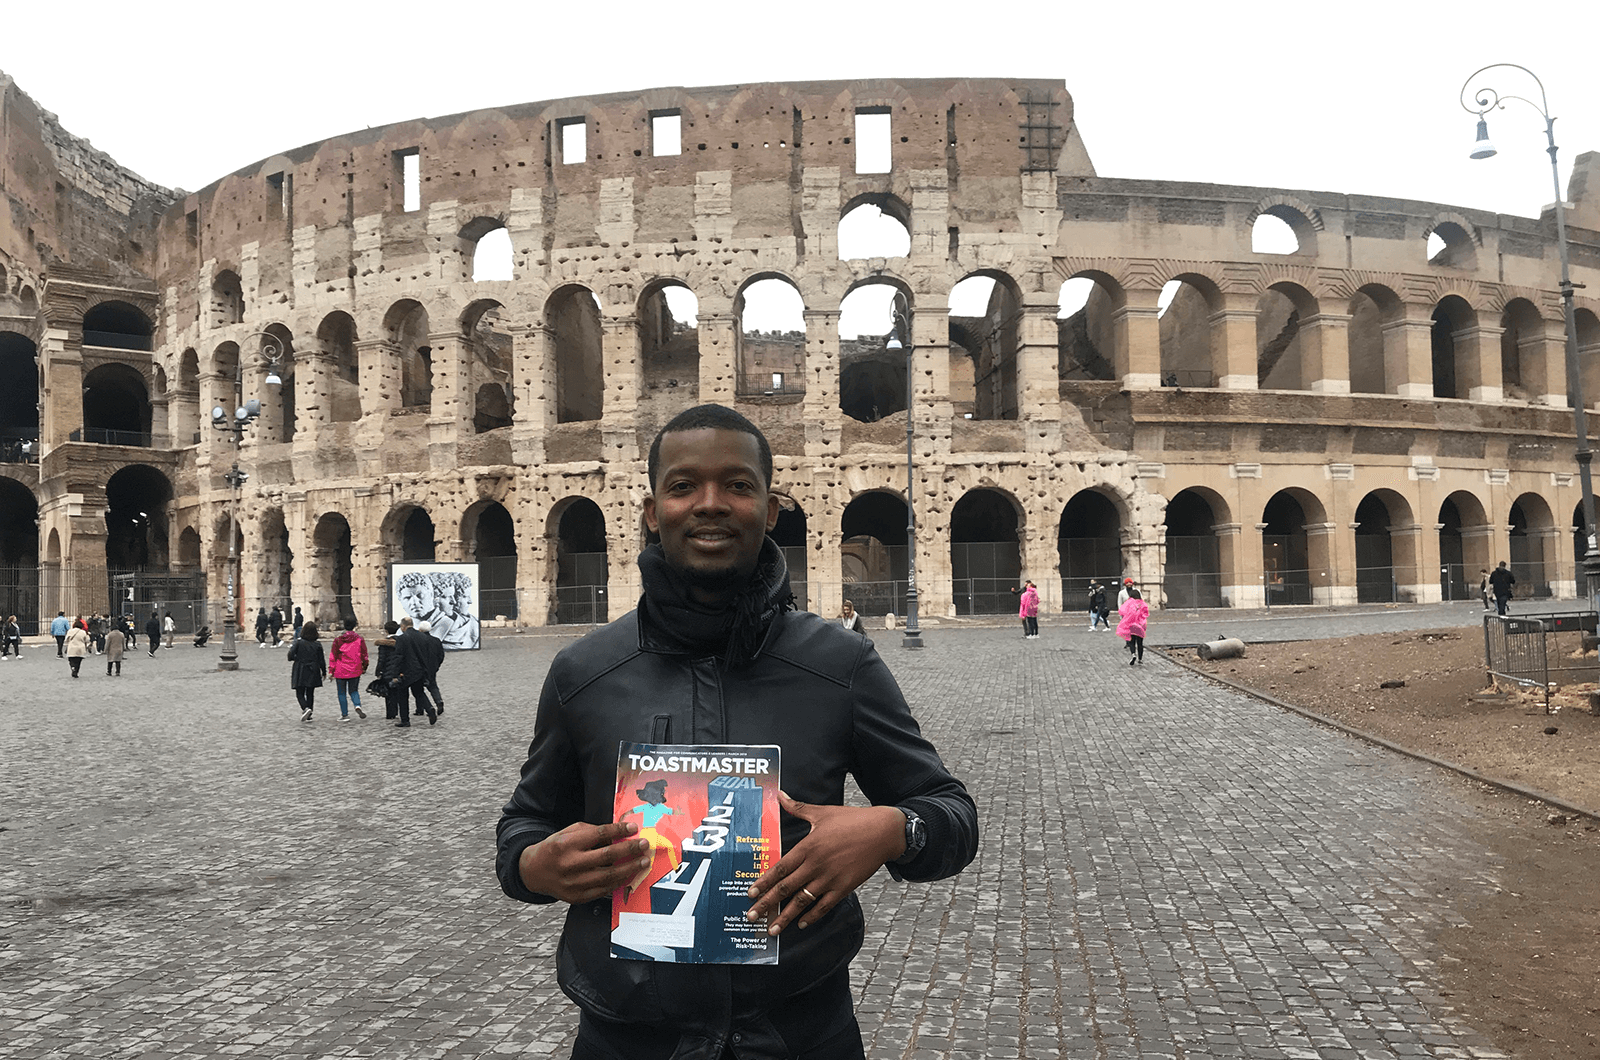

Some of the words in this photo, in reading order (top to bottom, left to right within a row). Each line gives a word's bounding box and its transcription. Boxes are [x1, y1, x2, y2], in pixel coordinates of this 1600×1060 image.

[628, 754, 770, 775] TOASTMASTER
[710, 776, 763, 790] GOAL
[736, 836, 770, 844] Reframe
[751, 844, 770, 852] Your
[753, 852, 770, 861] Life
